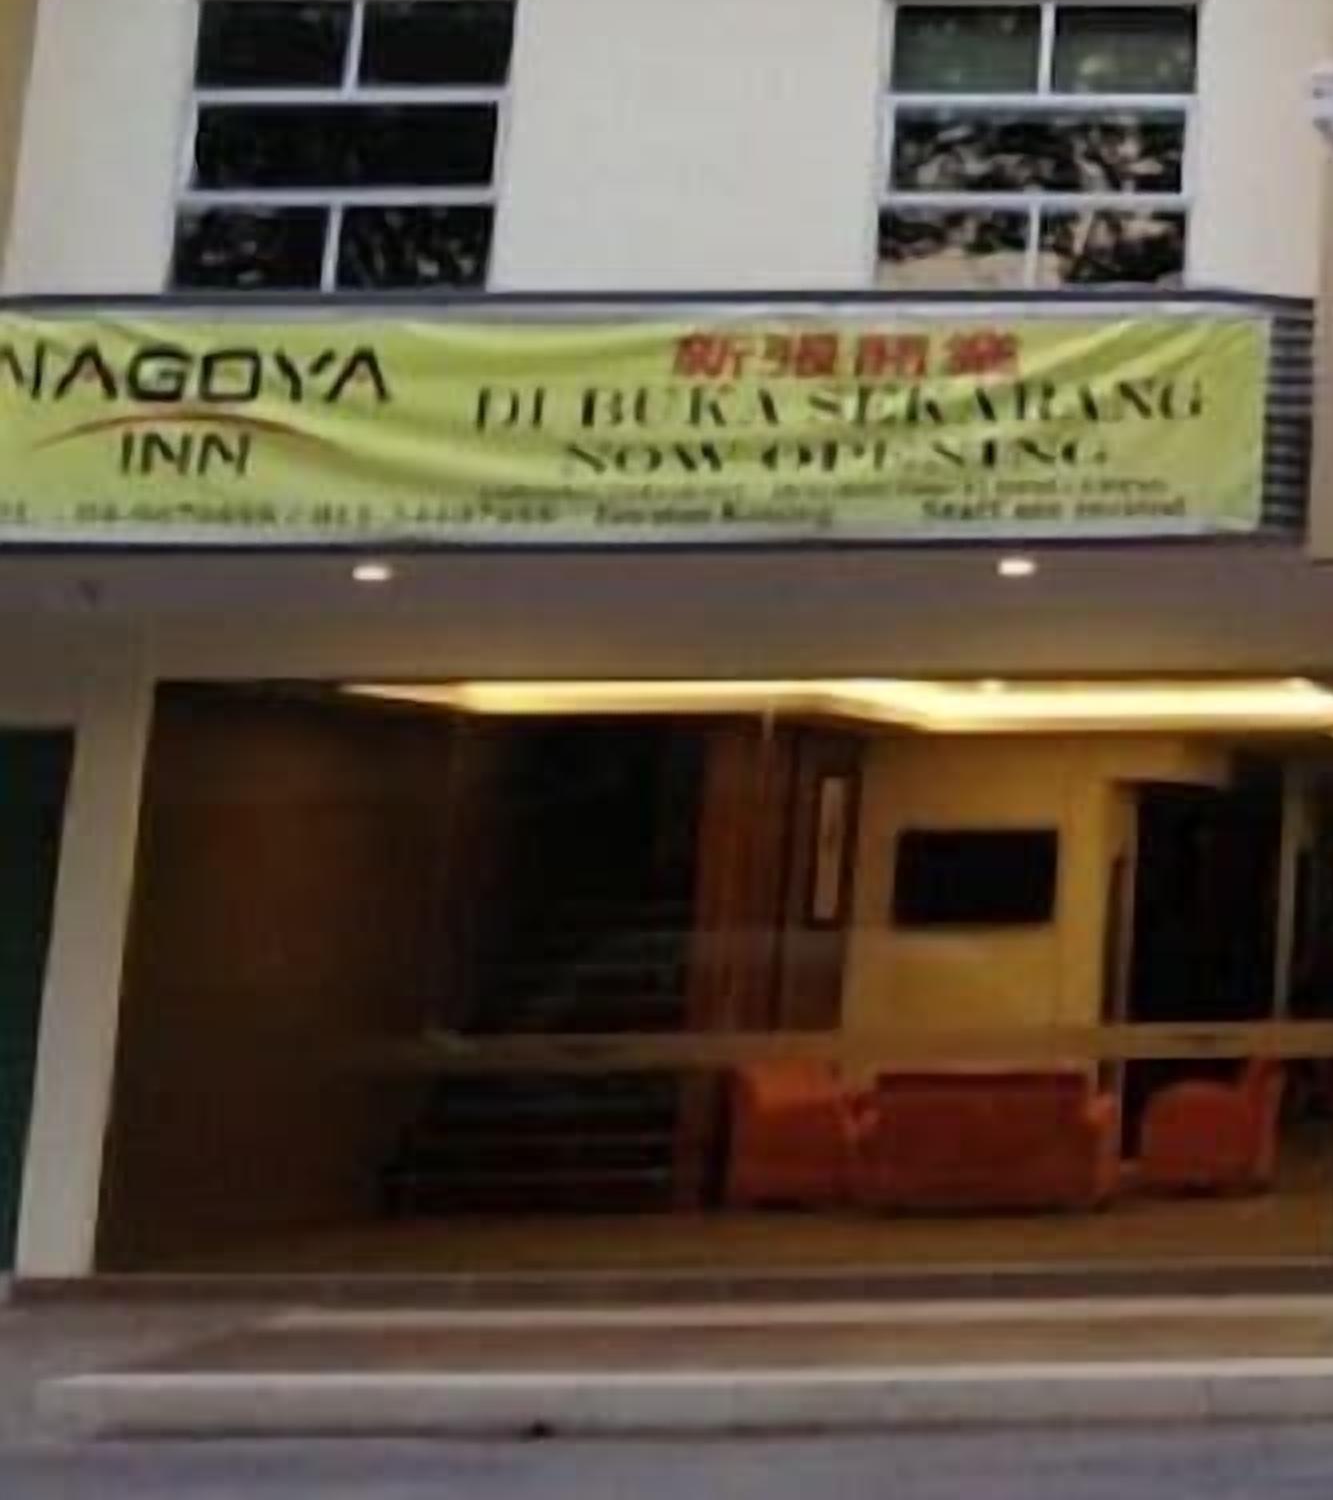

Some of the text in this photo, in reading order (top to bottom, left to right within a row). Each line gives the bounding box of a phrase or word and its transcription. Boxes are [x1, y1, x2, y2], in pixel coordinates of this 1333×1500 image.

[0, 342, 390, 402] NAGOYA
[475, 378, 1204, 430] DI BUKA SEKARANG
[118, 431, 252, 476] INN
[561, 436, 1108, 473] NOW OPENING
